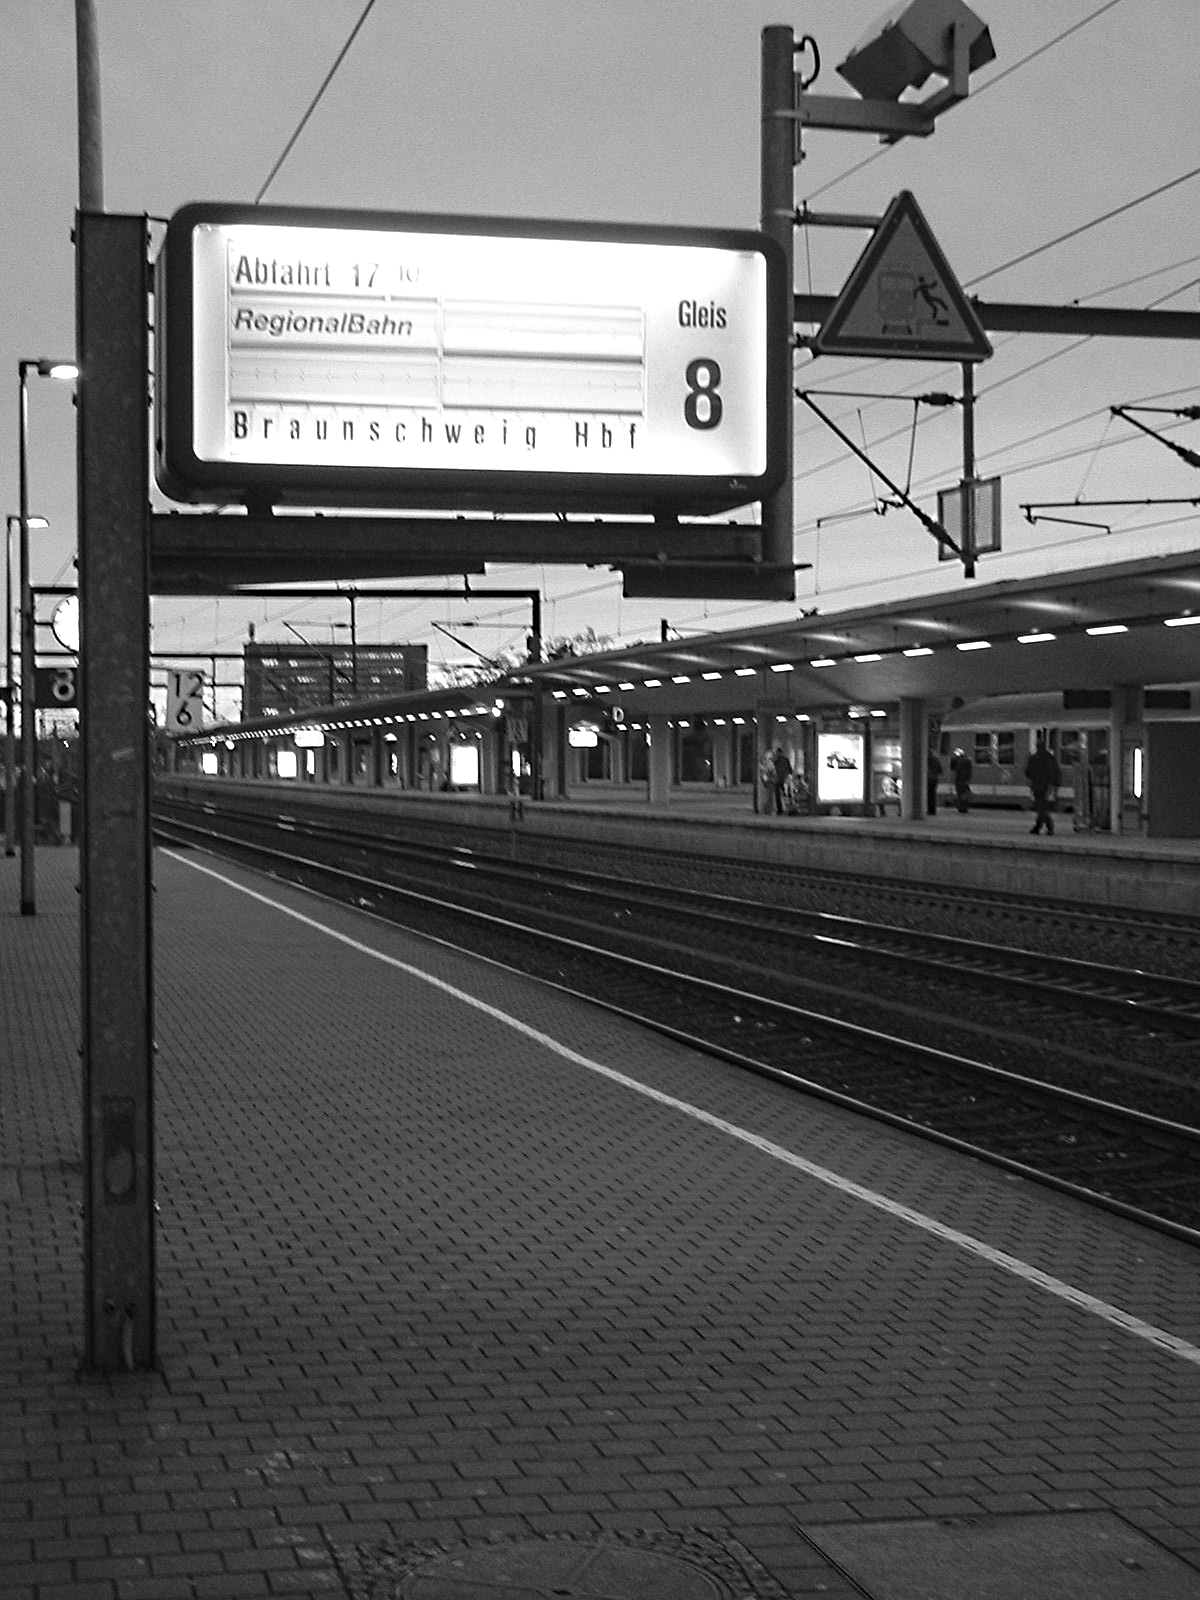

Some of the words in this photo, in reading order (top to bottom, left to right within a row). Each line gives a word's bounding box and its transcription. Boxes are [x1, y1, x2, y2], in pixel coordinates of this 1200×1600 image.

[235, 255, 331, 288] Abfahrt
[352, 262, 380, 288] 17
[234, 308, 413, 337] RegionalBahn
[678, 300, 727, 329] Gleis
[684, 357, 723, 431] 8
[233, 411, 537, 452] Braunschweig
[575, 420, 637, 449] Hbf
[173, 673, 203, 699] 12
[176, 700, 192, 725] 6
